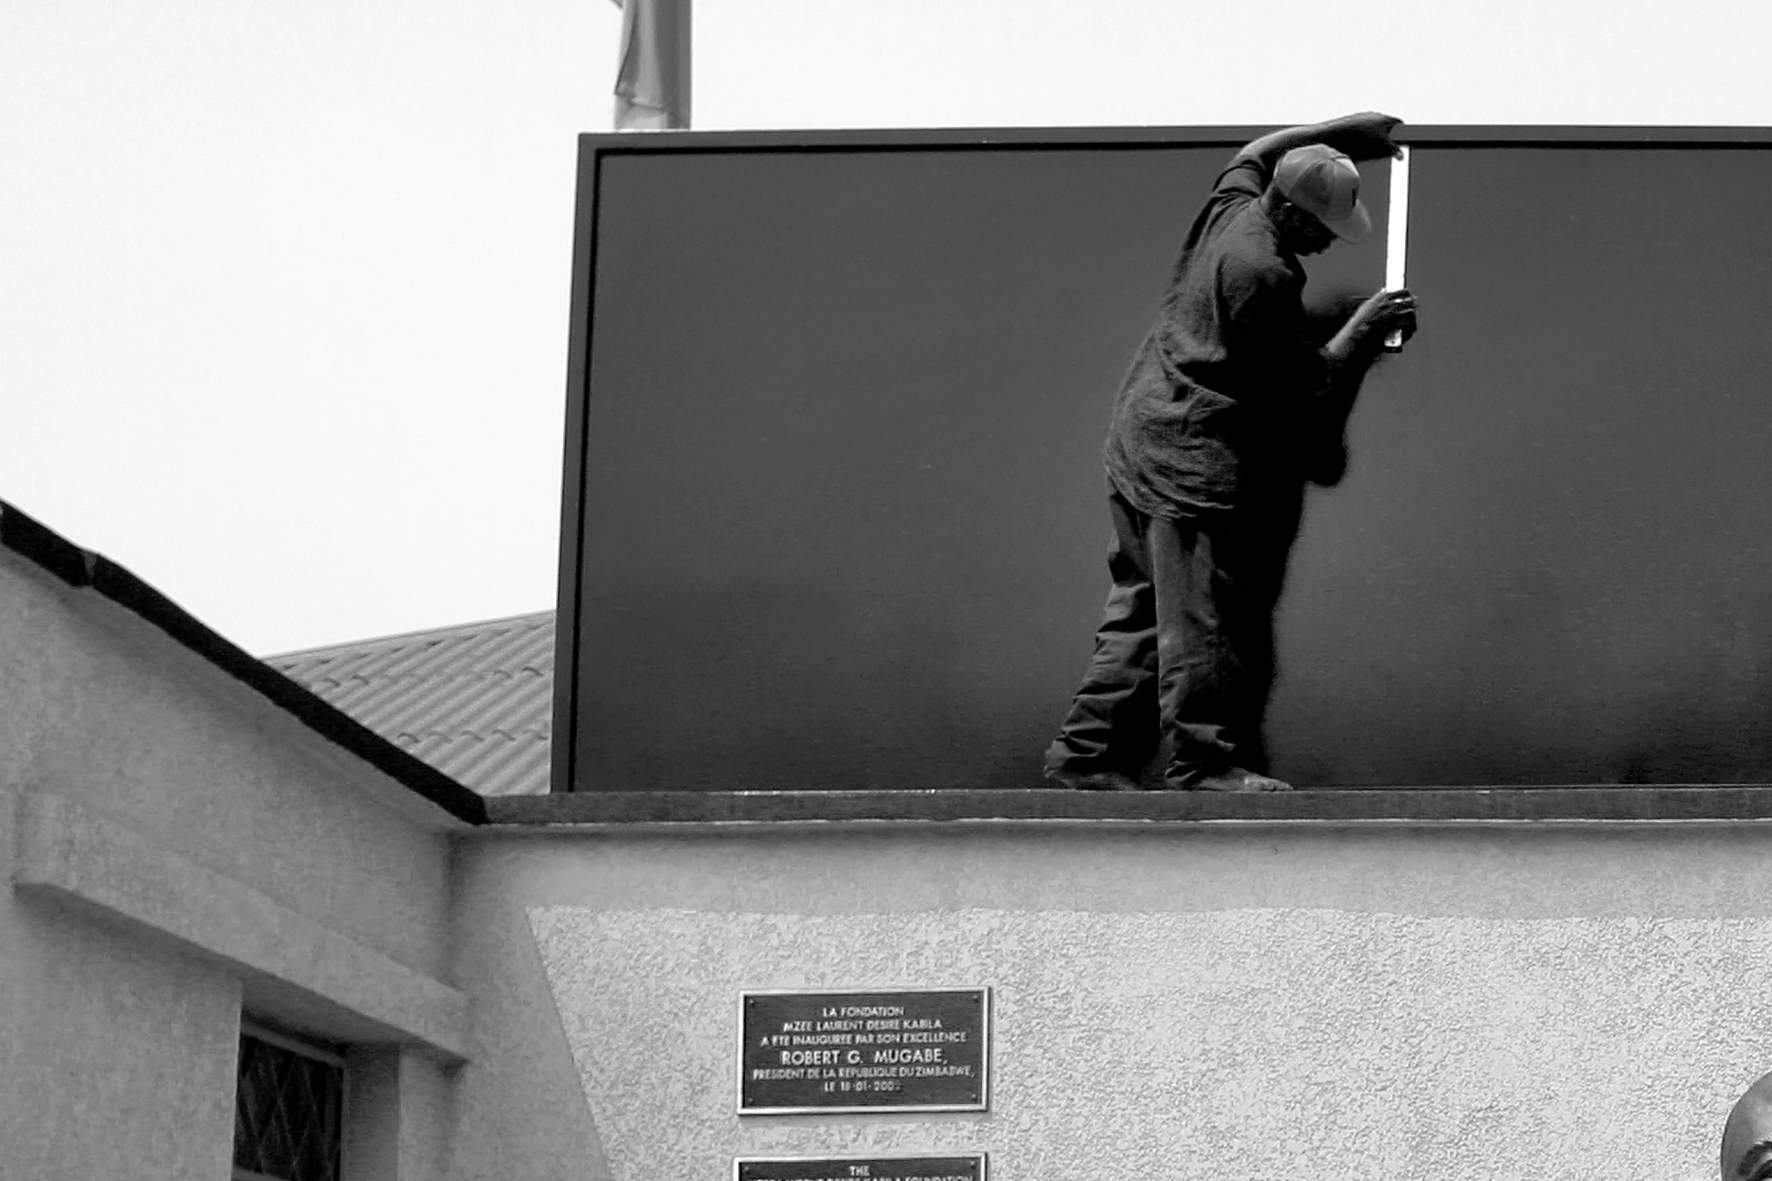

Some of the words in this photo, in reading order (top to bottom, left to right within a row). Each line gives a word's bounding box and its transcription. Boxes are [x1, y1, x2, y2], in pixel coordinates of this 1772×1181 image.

[823, 1008, 837, 1017] LA
[841, 1007, 904, 1017] FONDATION
[783, 1021, 812, 1031] MZEE
[817, 1020, 863, 1031] LAURENT
[903, 1019, 942, 1029] KABILA
[761, 1036, 769, 1046] A
[856, 1034, 874, 1044] PAR
[877, 1034, 900, 1043] SON
[903, 1032, 966, 1043] EXCELLENCE
[782, 1051, 840, 1065] ROBERT
[848, 1051, 863, 1063] G.
[874, 1049, 948, 1064] MUGABE,
[753, 1069, 804, 1079] PRESIDENT
[807, 1069, 819, 1079] DE
[823, 1069, 836, 1078] LA
[839, 1067, 897, 1078] REPUBLIQUE
[899, 1067, 914, 1077] DU
[825, 1082, 835, 1091] LE
[849, 1166, 869, 1176] THE
